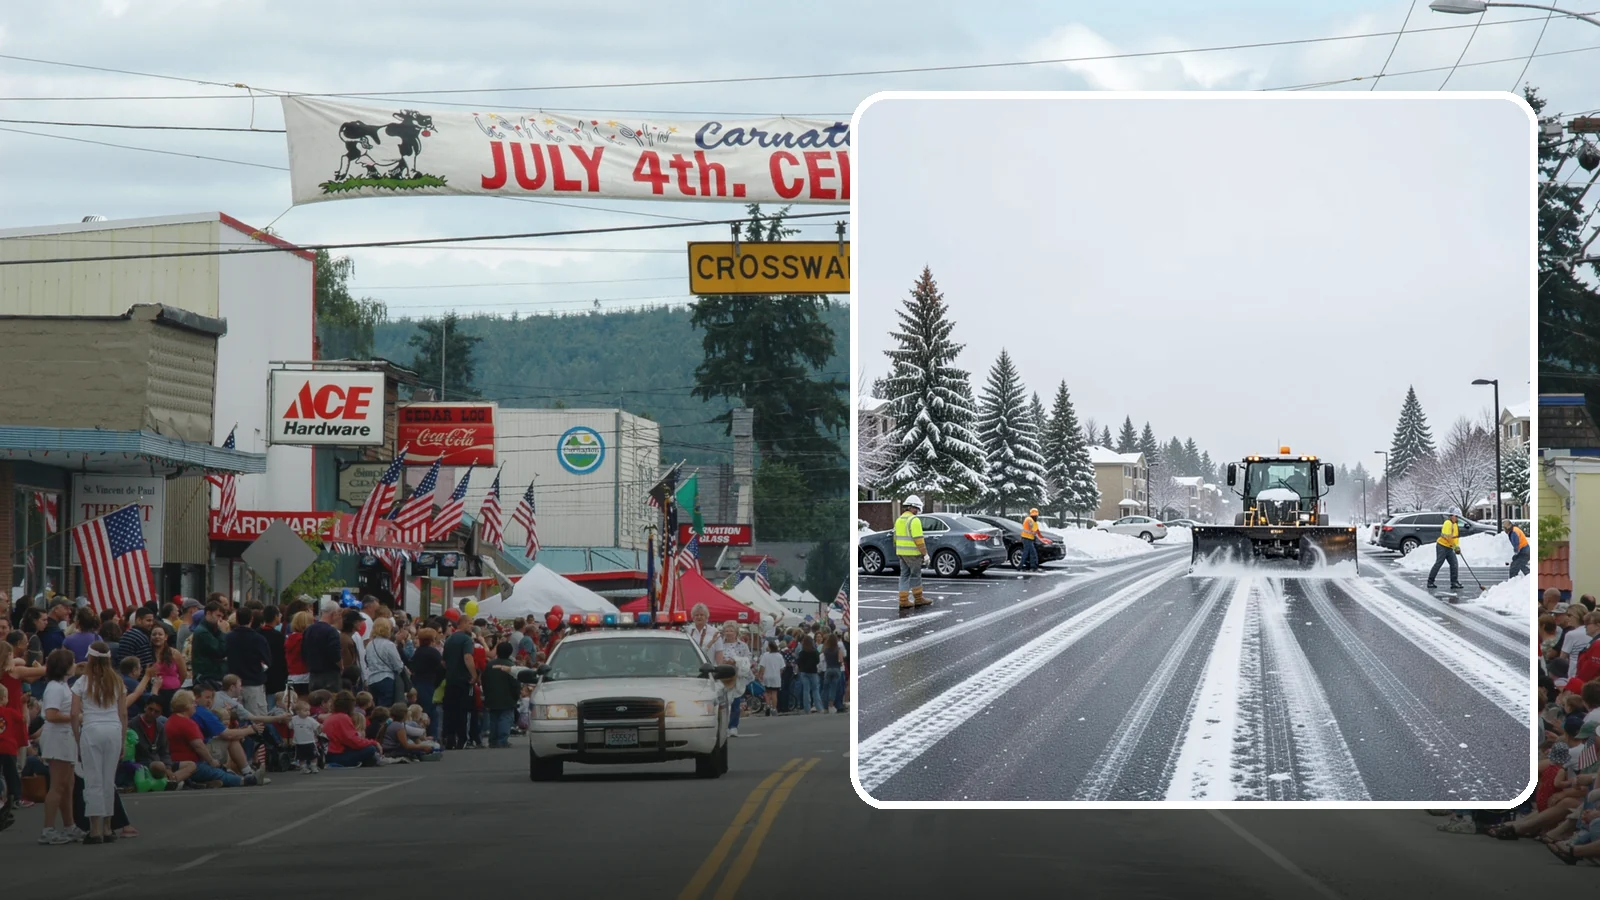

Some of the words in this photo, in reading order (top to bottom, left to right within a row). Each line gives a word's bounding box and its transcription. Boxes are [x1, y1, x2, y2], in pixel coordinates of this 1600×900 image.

[481, 141, 605, 193] JULY
[632, 150, 746, 198] 4th.
[697, 254, 850, 280] CROSSWA
[283, 380, 374, 420] ACE
[406, 409, 453, 422] CEDAR
[283, 421, 371, 436] Hardware
[96, 485, 124, 495] Vincent
[126, 486, 136, 494] de
[138, 486, 155, 495] Paul
[81, 503, 154, 522] THT
[688, 526, 741, 535] CRNATION
[699, 535, 730, 543] GLASS
